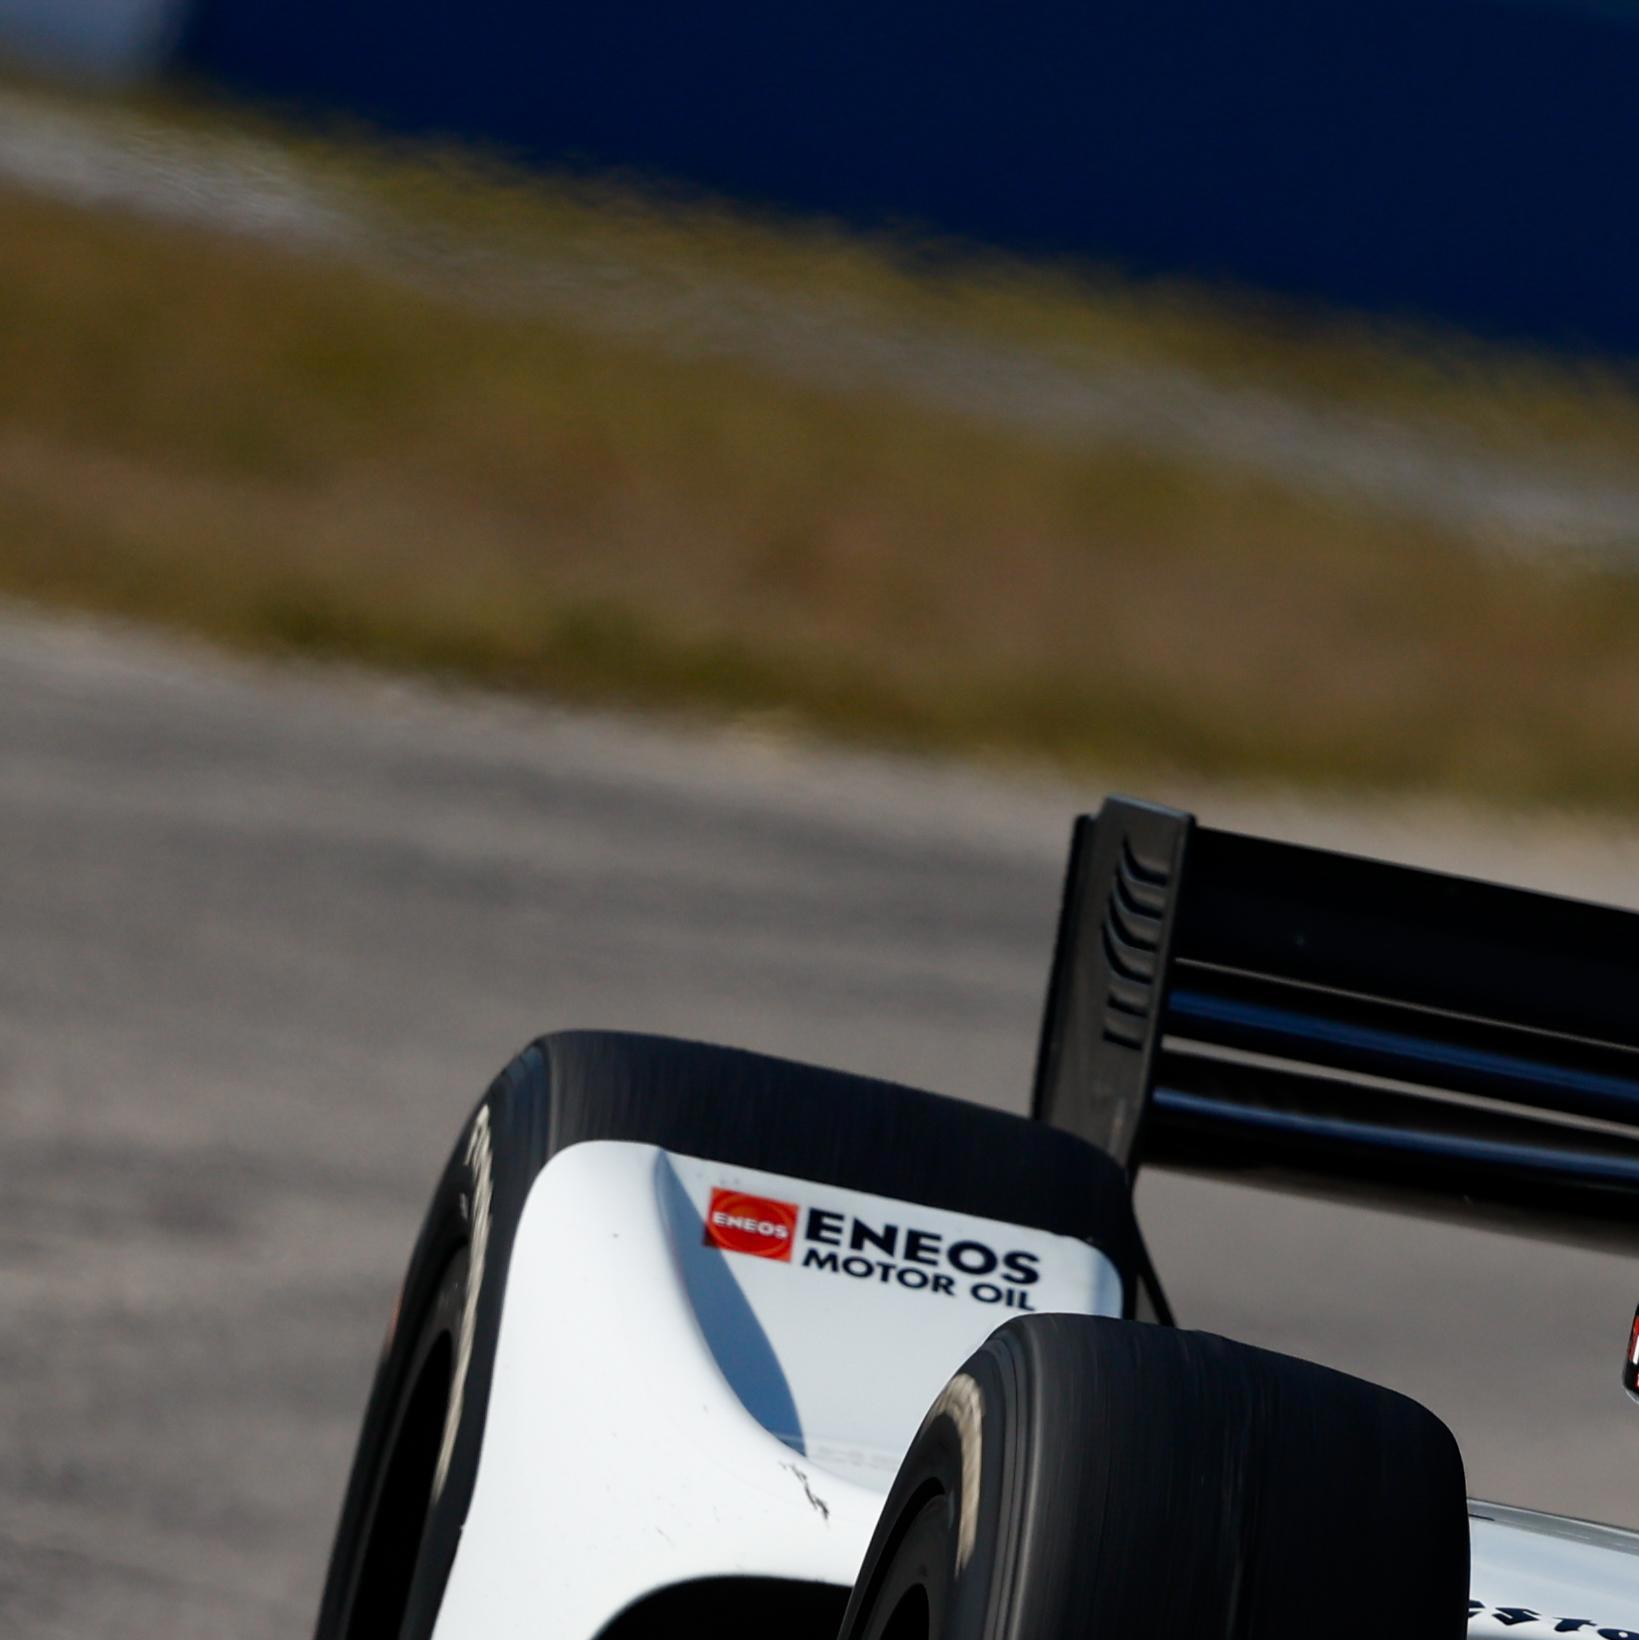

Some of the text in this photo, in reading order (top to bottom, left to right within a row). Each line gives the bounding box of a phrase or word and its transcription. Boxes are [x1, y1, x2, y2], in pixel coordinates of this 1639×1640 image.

[712, 1210, 789, 1241] ENEOS
[805, 1206, 1041, 1285] ENEOS
[802, 1249, 1036, 1312] MOTOR OIL
